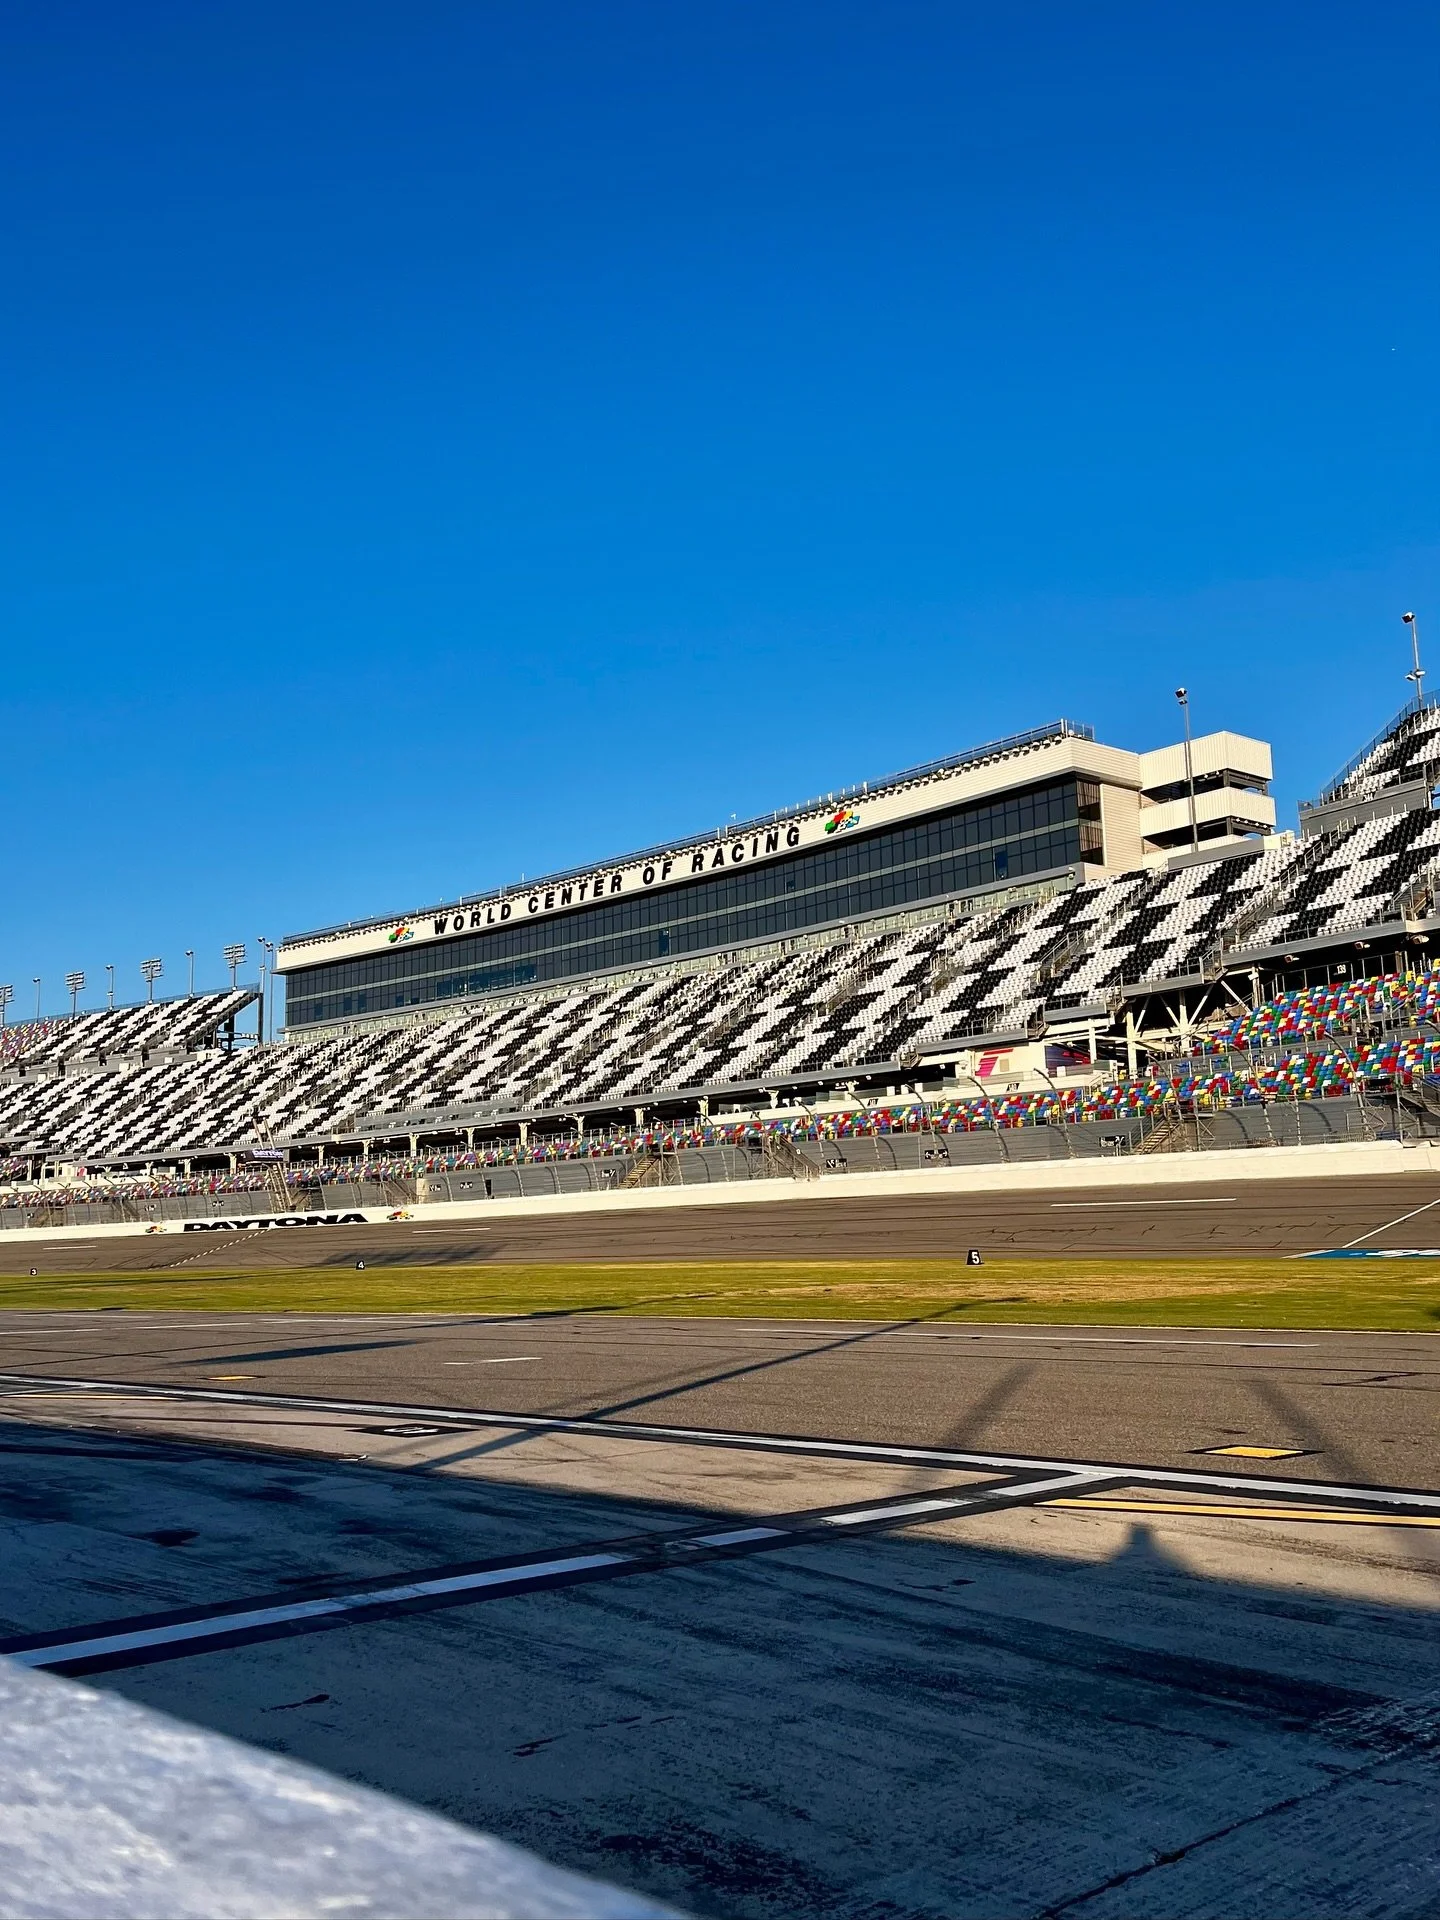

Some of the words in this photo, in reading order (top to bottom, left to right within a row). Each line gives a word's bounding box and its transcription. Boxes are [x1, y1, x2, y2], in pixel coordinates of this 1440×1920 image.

[434, 904, 511, 935] WORLD
[528, 875, 622, 913] CENTER
[642, 861, 673, 885] OF
[692, 827, 799, 872] RACING
[183, 1214, 368, 1232] DAYTONA
[972, 1251, 980, 1264] 5
